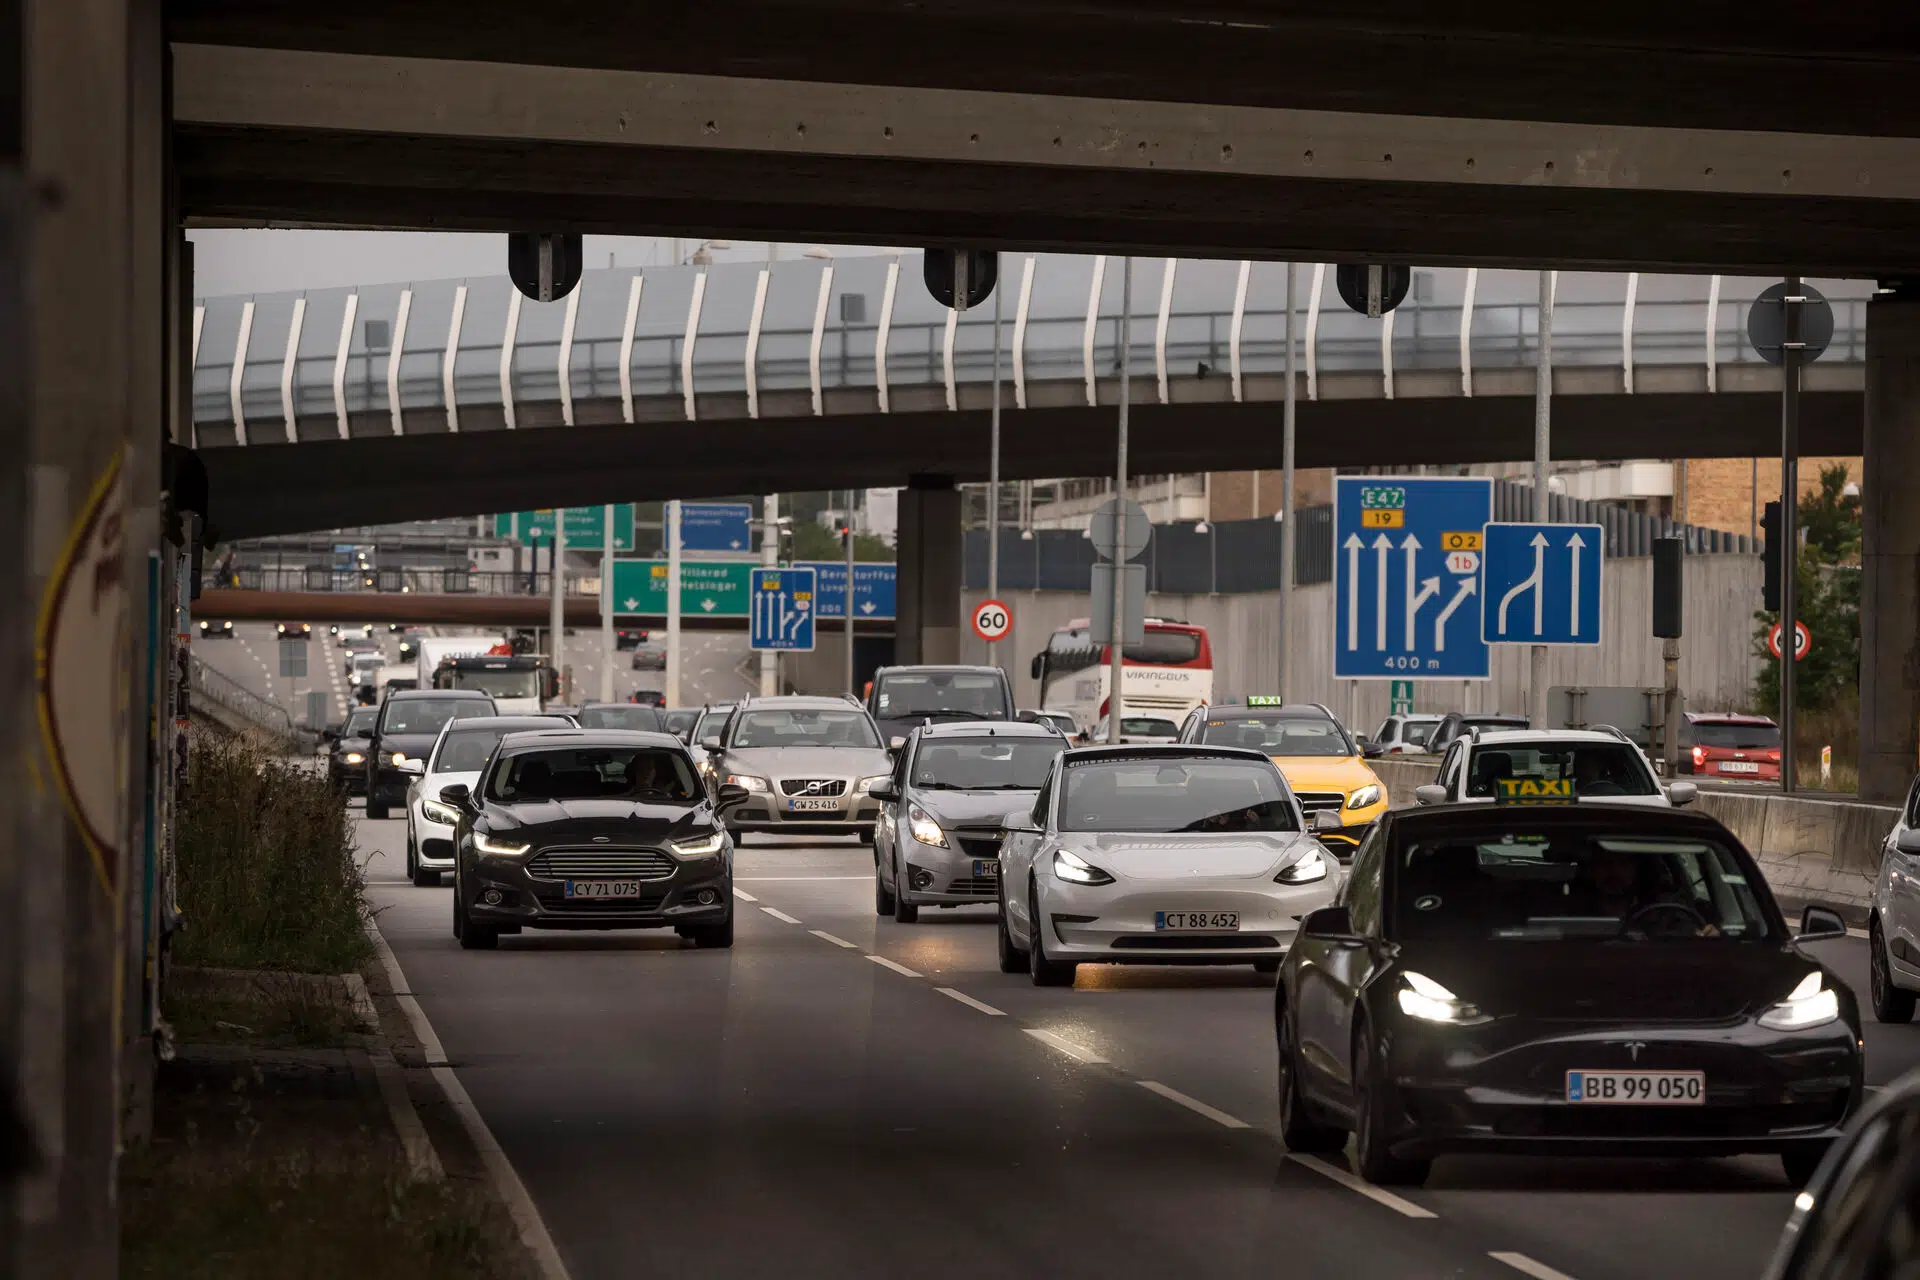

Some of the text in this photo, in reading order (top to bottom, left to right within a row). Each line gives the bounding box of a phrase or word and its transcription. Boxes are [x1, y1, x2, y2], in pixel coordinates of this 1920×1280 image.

[1366, 491, 1400, 504] E47
[1374, 512, 1392, 525] 19
[1454, 556, 1473, 570] 1b
[979, 612, 1005, 629] 60
[1384, 655, 1440, 669] 400 m
[1249, 695, 1281, 705] TAXI
[1501, 780, 1571, 796] TAXI
[794, 801, 838, 809] GW 25 416
[574, 883, 592, 895] CY
[595, 883, 610, 895] 71
[614, 883, 638, 895] 075
[1166, 913, 1186, 927] CT
[1189, 913, 1207, 927] 88
[1210, 913, 1237, 927] 452
[1586, 1077, 1700, 1098] BB 99 050
